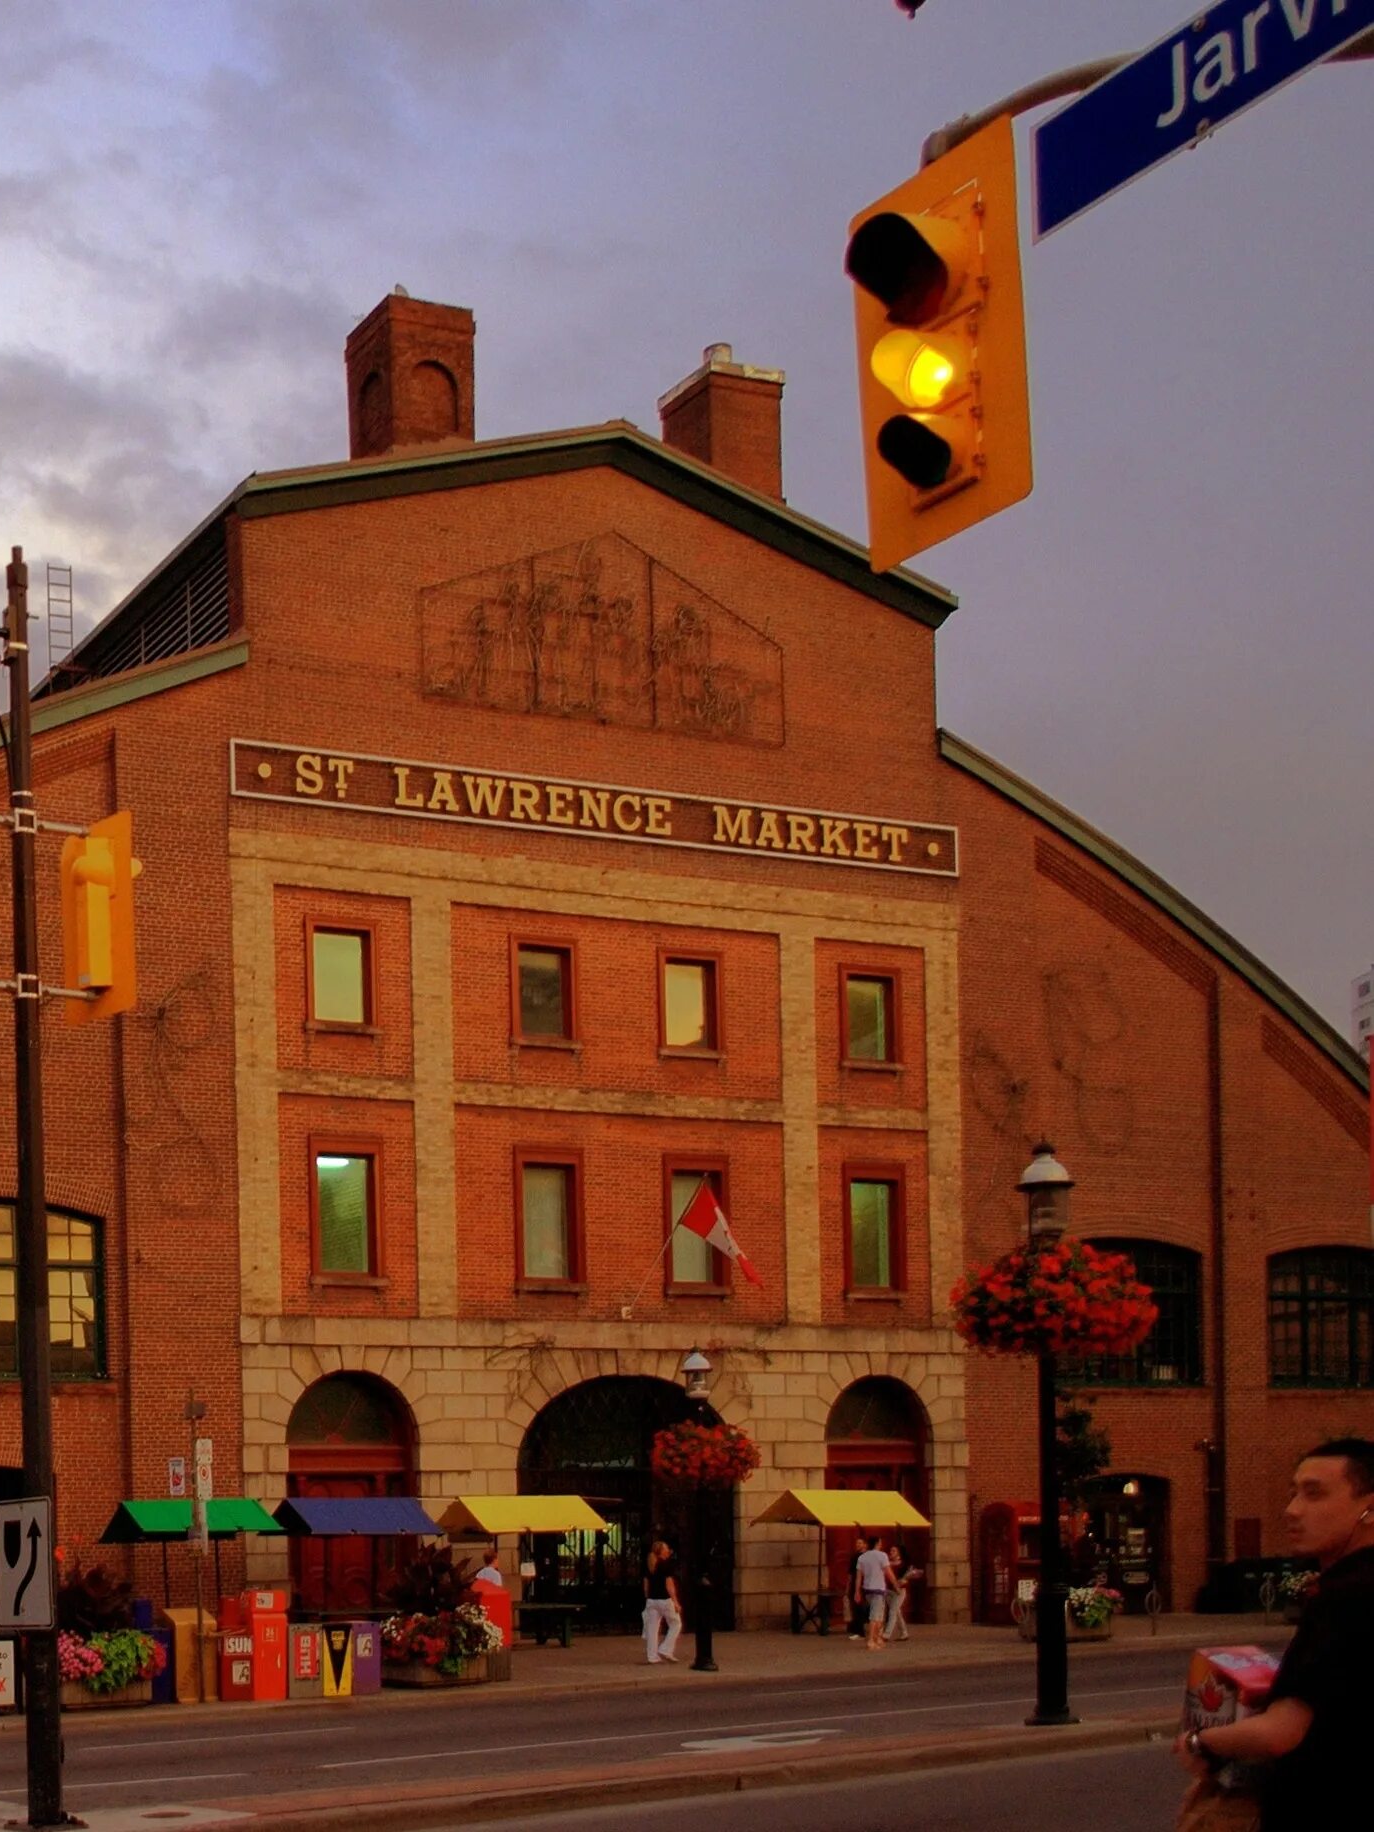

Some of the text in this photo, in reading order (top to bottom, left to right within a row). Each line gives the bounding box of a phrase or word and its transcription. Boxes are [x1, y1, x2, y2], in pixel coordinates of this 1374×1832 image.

[394, 765, 672, 837] LAWRENCE
[713, 805, 909, 863] MARKET
[227, 1637, 252, 1653] SUN
[0, 1650, 8, 1660] to
